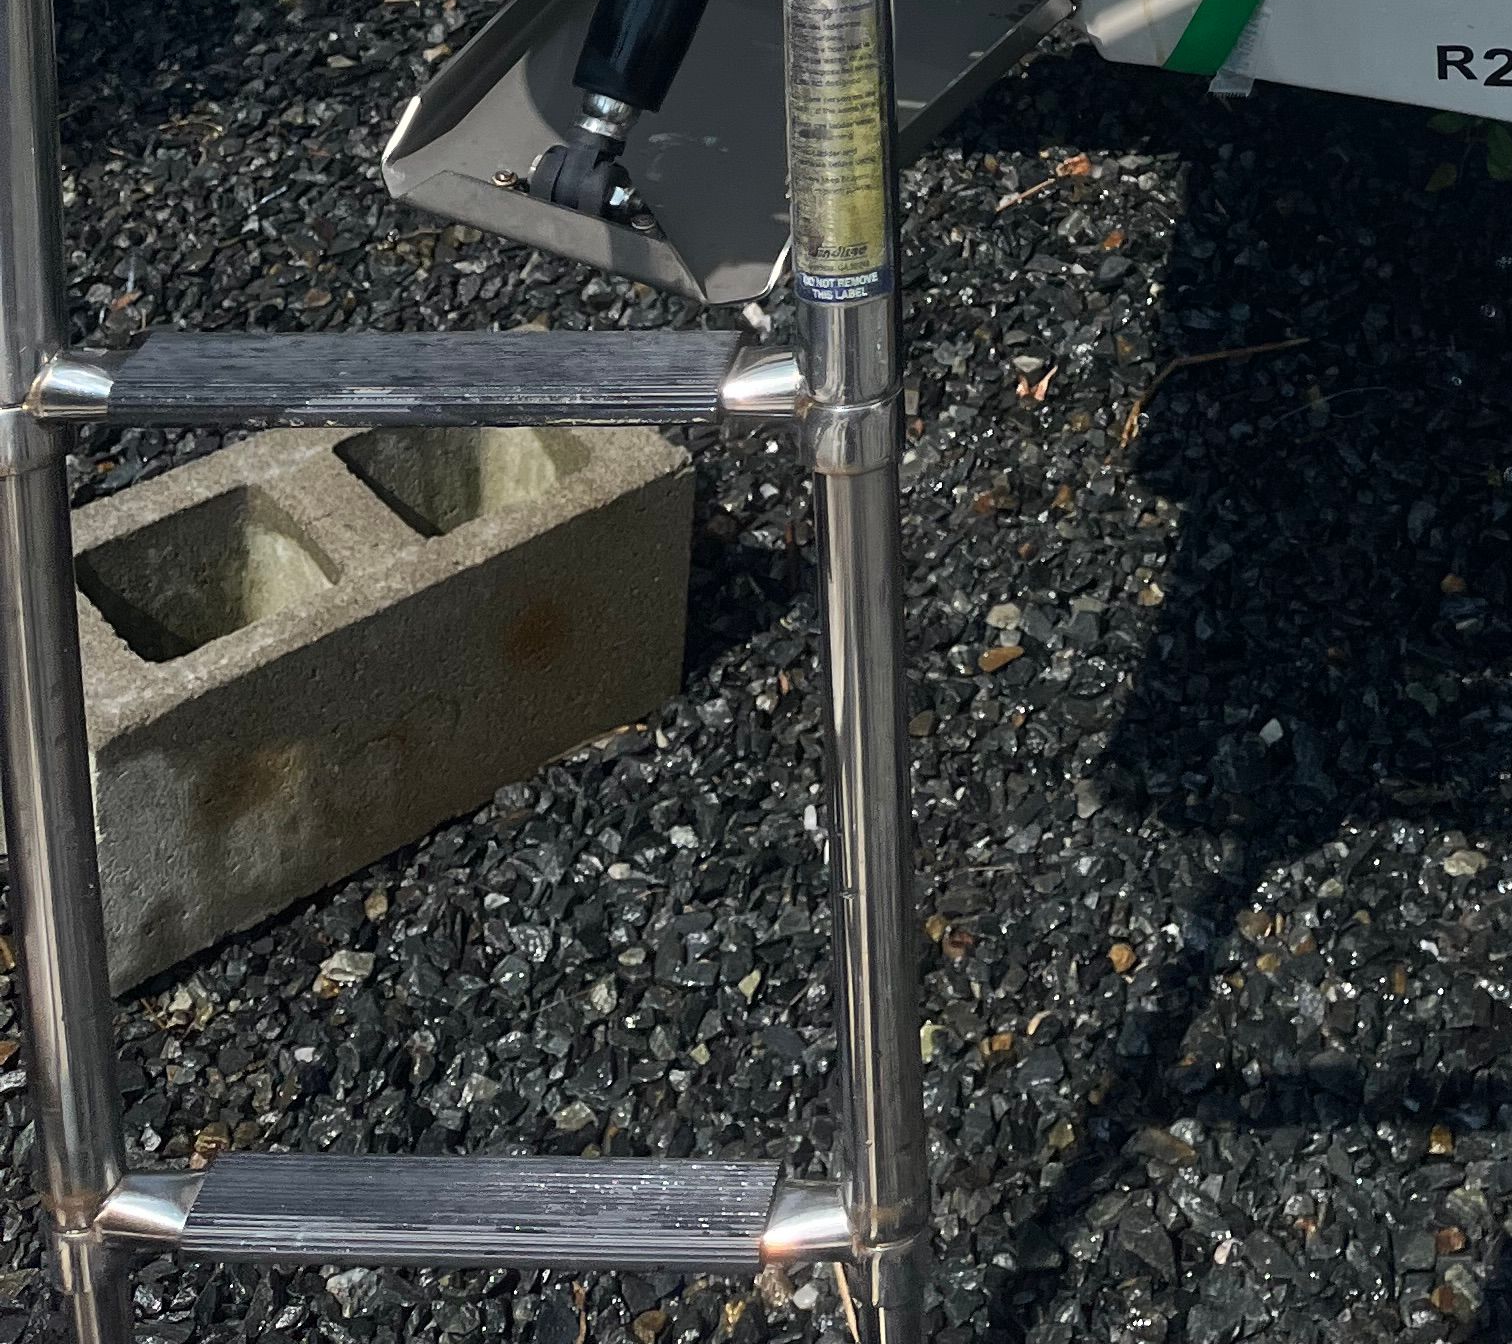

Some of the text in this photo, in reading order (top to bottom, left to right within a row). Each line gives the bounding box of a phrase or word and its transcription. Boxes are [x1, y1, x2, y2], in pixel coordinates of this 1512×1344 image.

[802, 272, 879, 288] DO NOT REMOVE
[812, 287, 868, 300] THIS LABEL
